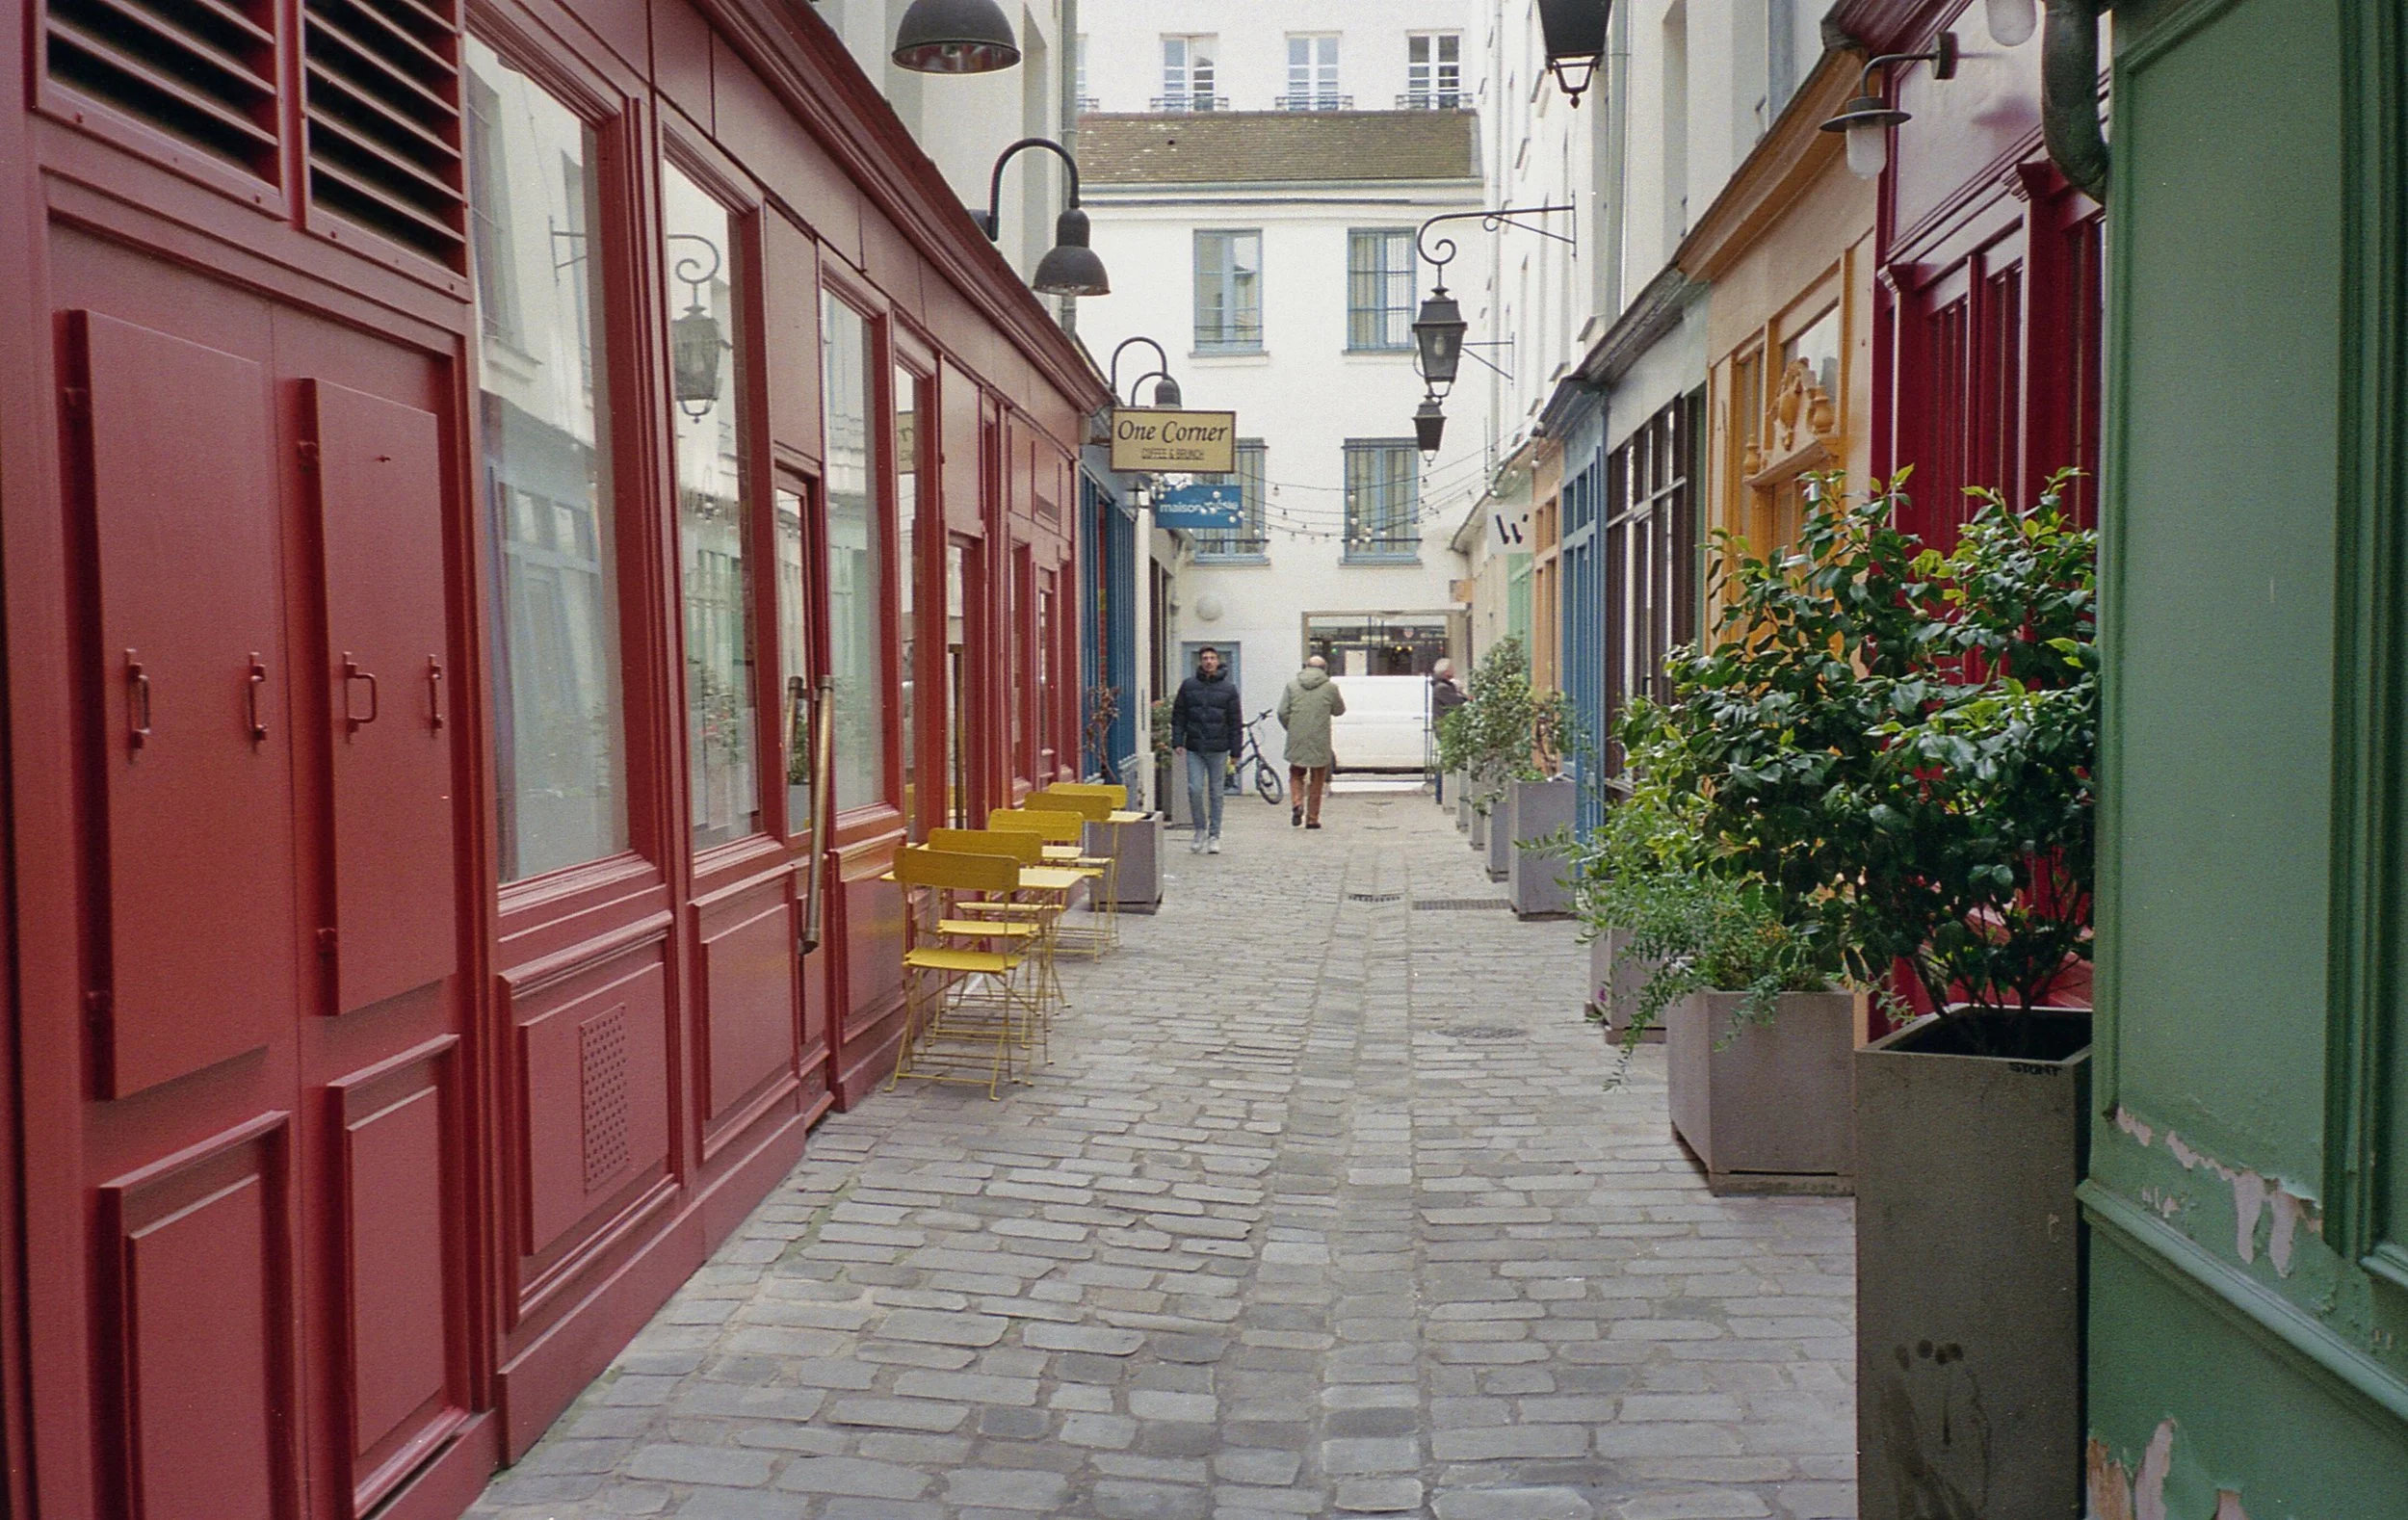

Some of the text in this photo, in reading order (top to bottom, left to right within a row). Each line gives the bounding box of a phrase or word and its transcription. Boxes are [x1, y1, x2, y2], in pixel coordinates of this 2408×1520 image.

[1117, 420, 1228, 443] One Corner
[1160, 502, 1202, 513] maison
